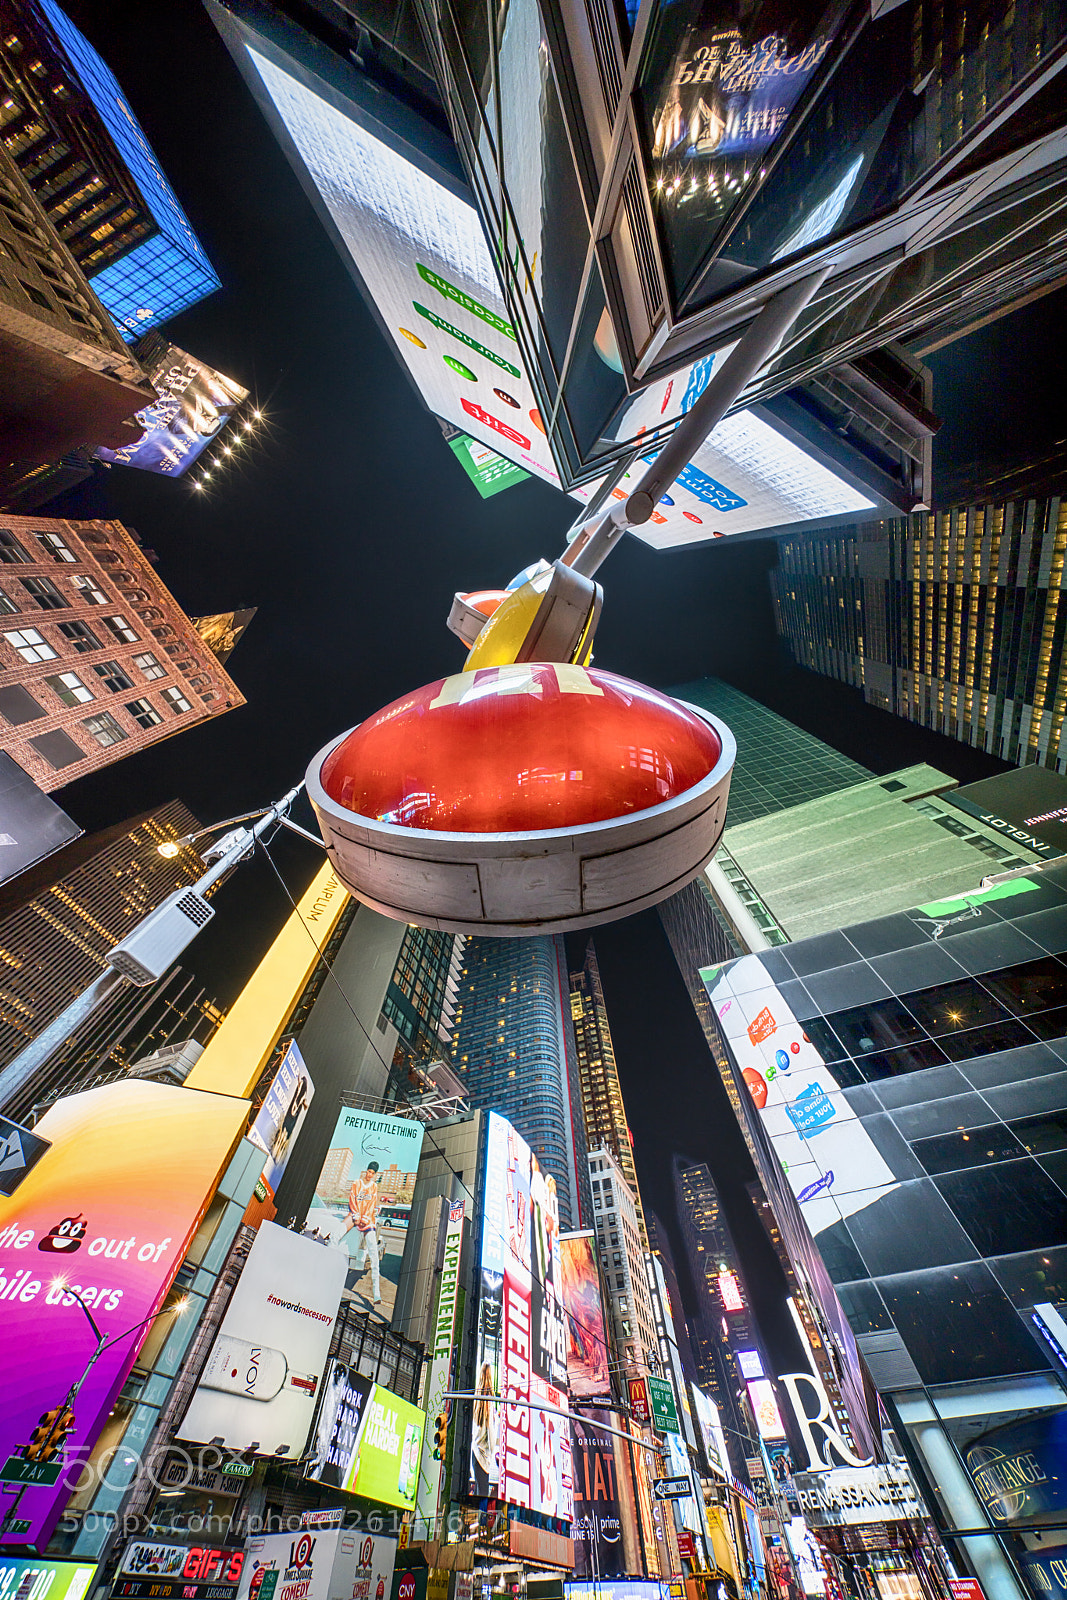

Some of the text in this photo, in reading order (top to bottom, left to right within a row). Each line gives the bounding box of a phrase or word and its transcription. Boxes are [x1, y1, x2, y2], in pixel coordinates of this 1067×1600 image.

[428, 311, 514, 374] Your name
[471, 405, 526, 445] Gift
[694, 478, 740, 506] your
[980, 814, 1051, 851] INGLOT
[344, 1115, 418, 1139] PRETTYLITTLETHING
[449, 1208, 463, 1221] NFL
[87, 1236, 136, 1261] out
[137, 1237, 173, 1264] of
[45, 1282, 125, 1312] users
[267, 1293, 334, 1327] #nowordsnecessary
[433, 1232, 461, 1361] EXPERIENCE
[244, 1348, 262, 1395] LVOV
[341, 1384, 363, 1409] WORK
[336, 1404, 359, 1428] HARD
[369, 1401, 399, 1433] RELAX
[331, 1423, 356, 1449] PLAY
[364, 1421, 401, 1457] HARDER
[578, 1437, 613, 1448] ORIGINAL
[19, 1464, 29, 1478] 7
[326, 1445, 351, 1470] HARD
[219, 1474, 244, 1495] T-SHIRT
[658, 1481, 688, 1494] ONE WAY
[600, 1514, 620, 1533] prime
[183, 1546, 245, 1582] GIFTS
[399, 1583, 415, 1598] CNY
